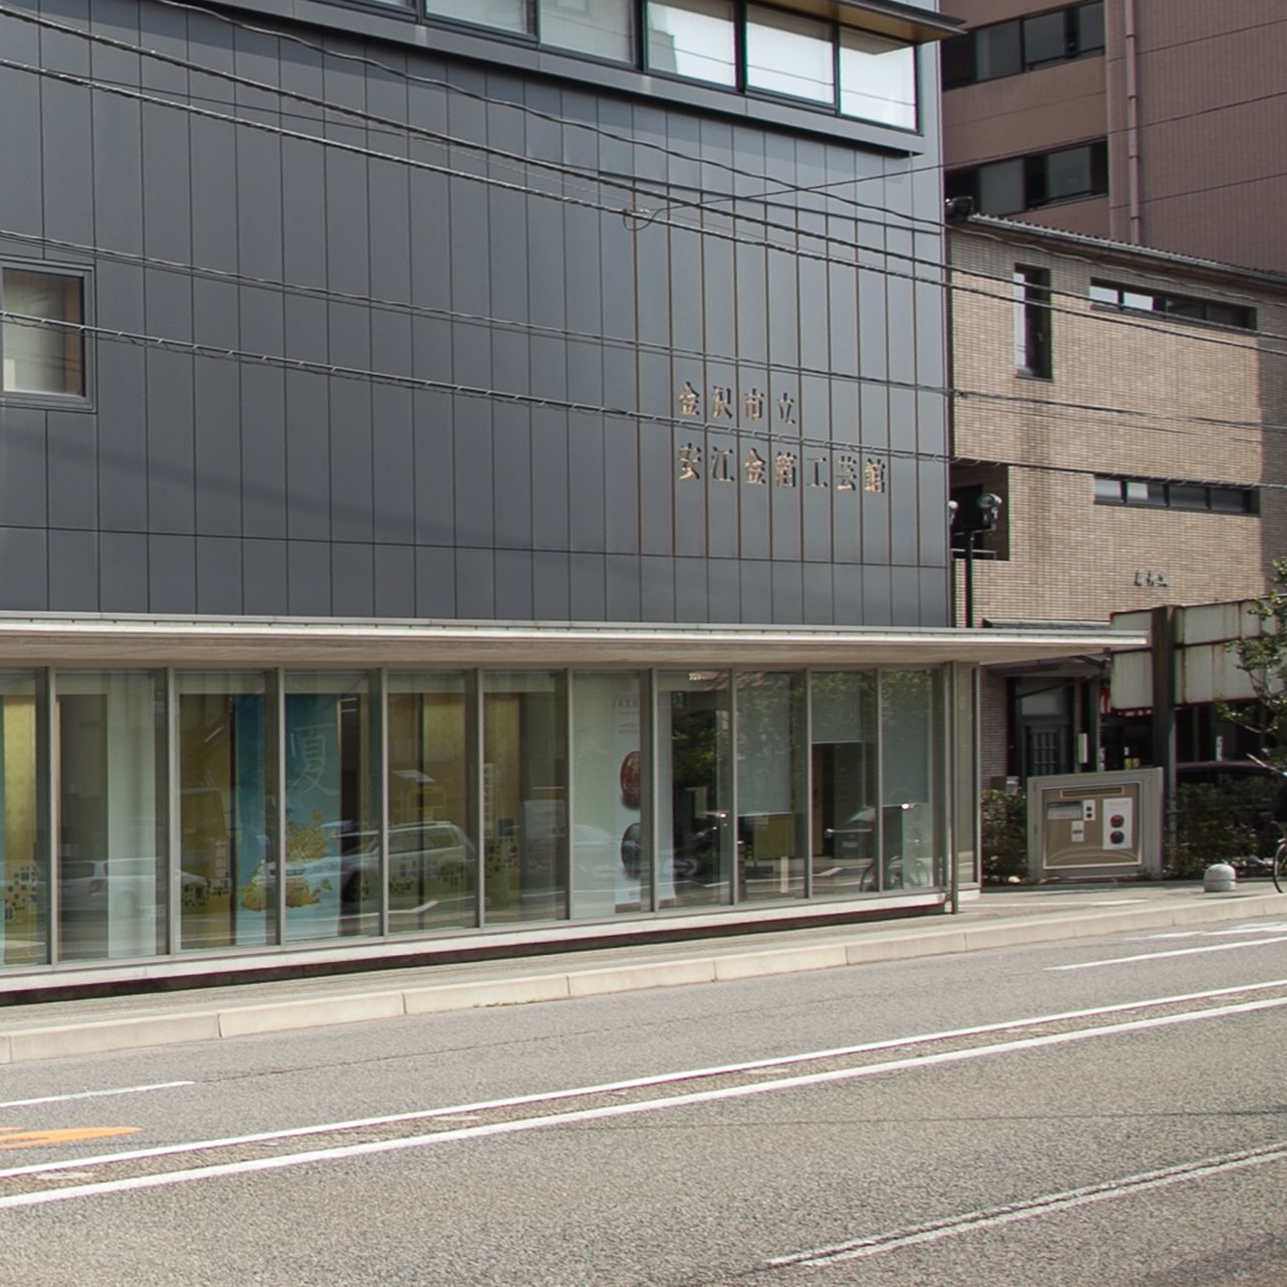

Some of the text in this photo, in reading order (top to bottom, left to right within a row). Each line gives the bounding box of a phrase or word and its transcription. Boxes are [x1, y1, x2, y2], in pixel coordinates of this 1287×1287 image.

[678, 381, 796, 425] 金沢市立
[678, 442, 886, 494] 安江金箔工芸館
